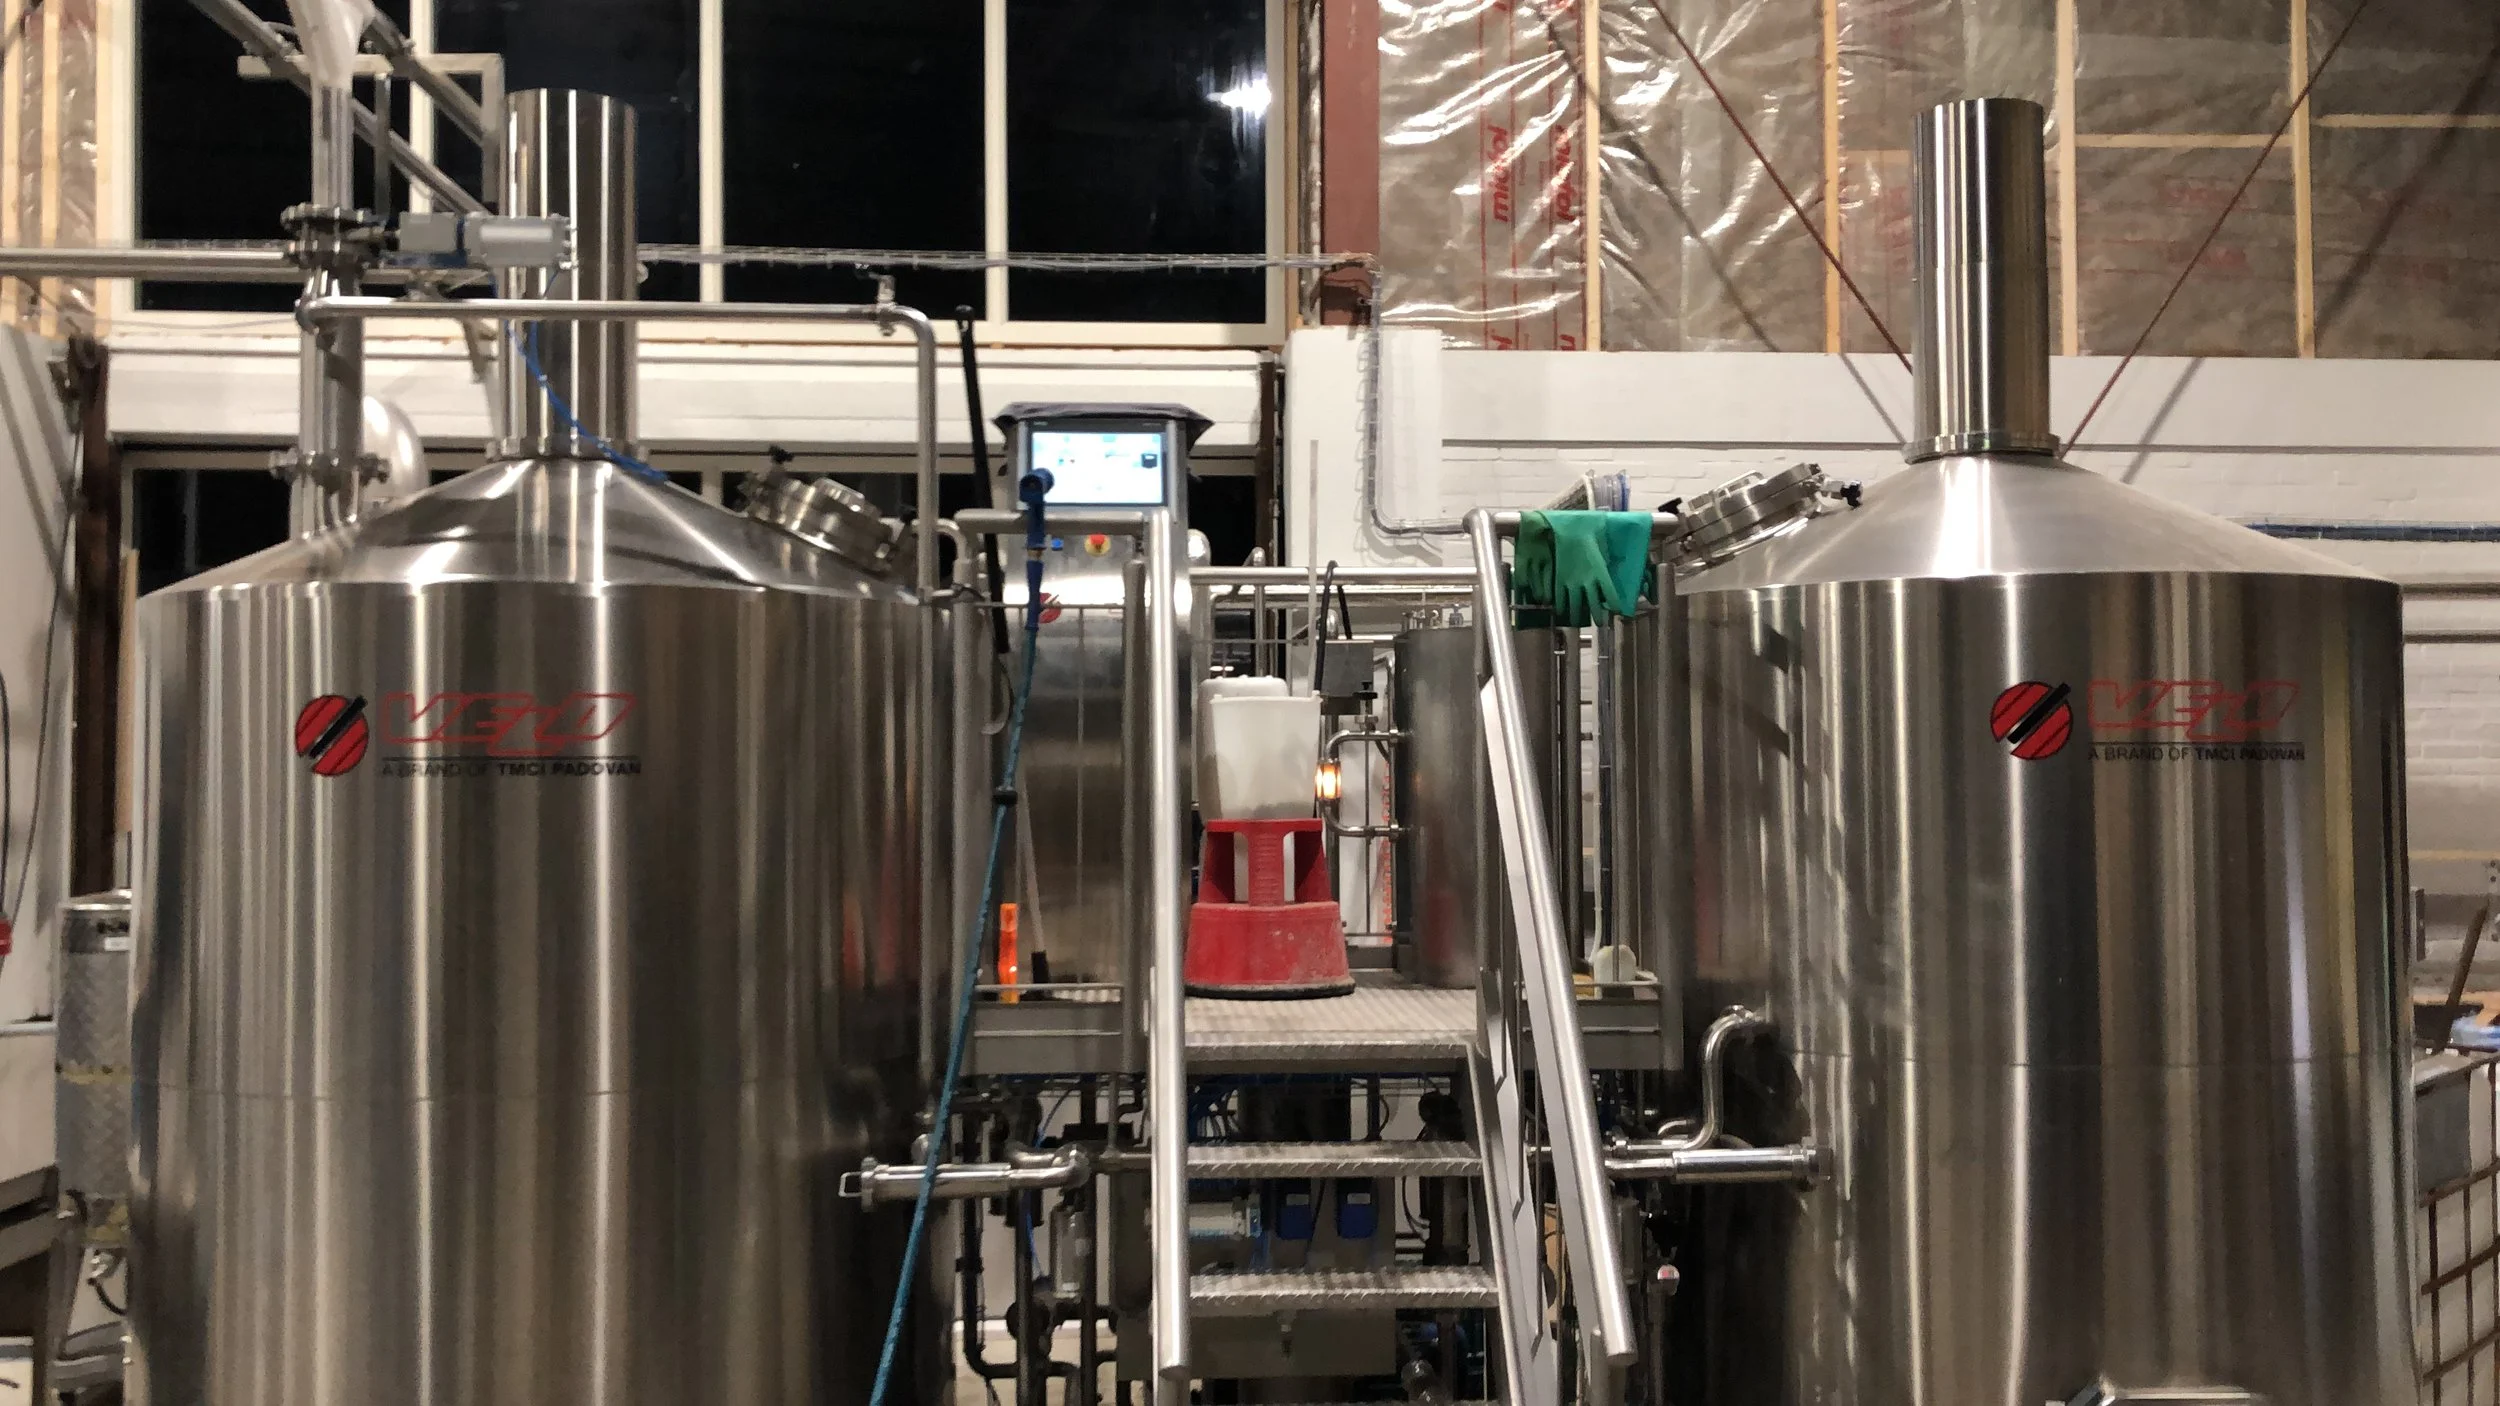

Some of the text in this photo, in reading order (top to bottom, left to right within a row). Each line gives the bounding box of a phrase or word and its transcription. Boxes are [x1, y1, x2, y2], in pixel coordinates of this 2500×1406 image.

[2087, 746, 2099, 760] A
[2104, 746, 2164, 761] BRAND
[2168, 746, 2192, 761] OF
[500, 762, 546, 776] TMCI
[552, 762, 642, 776] PADOVAN
